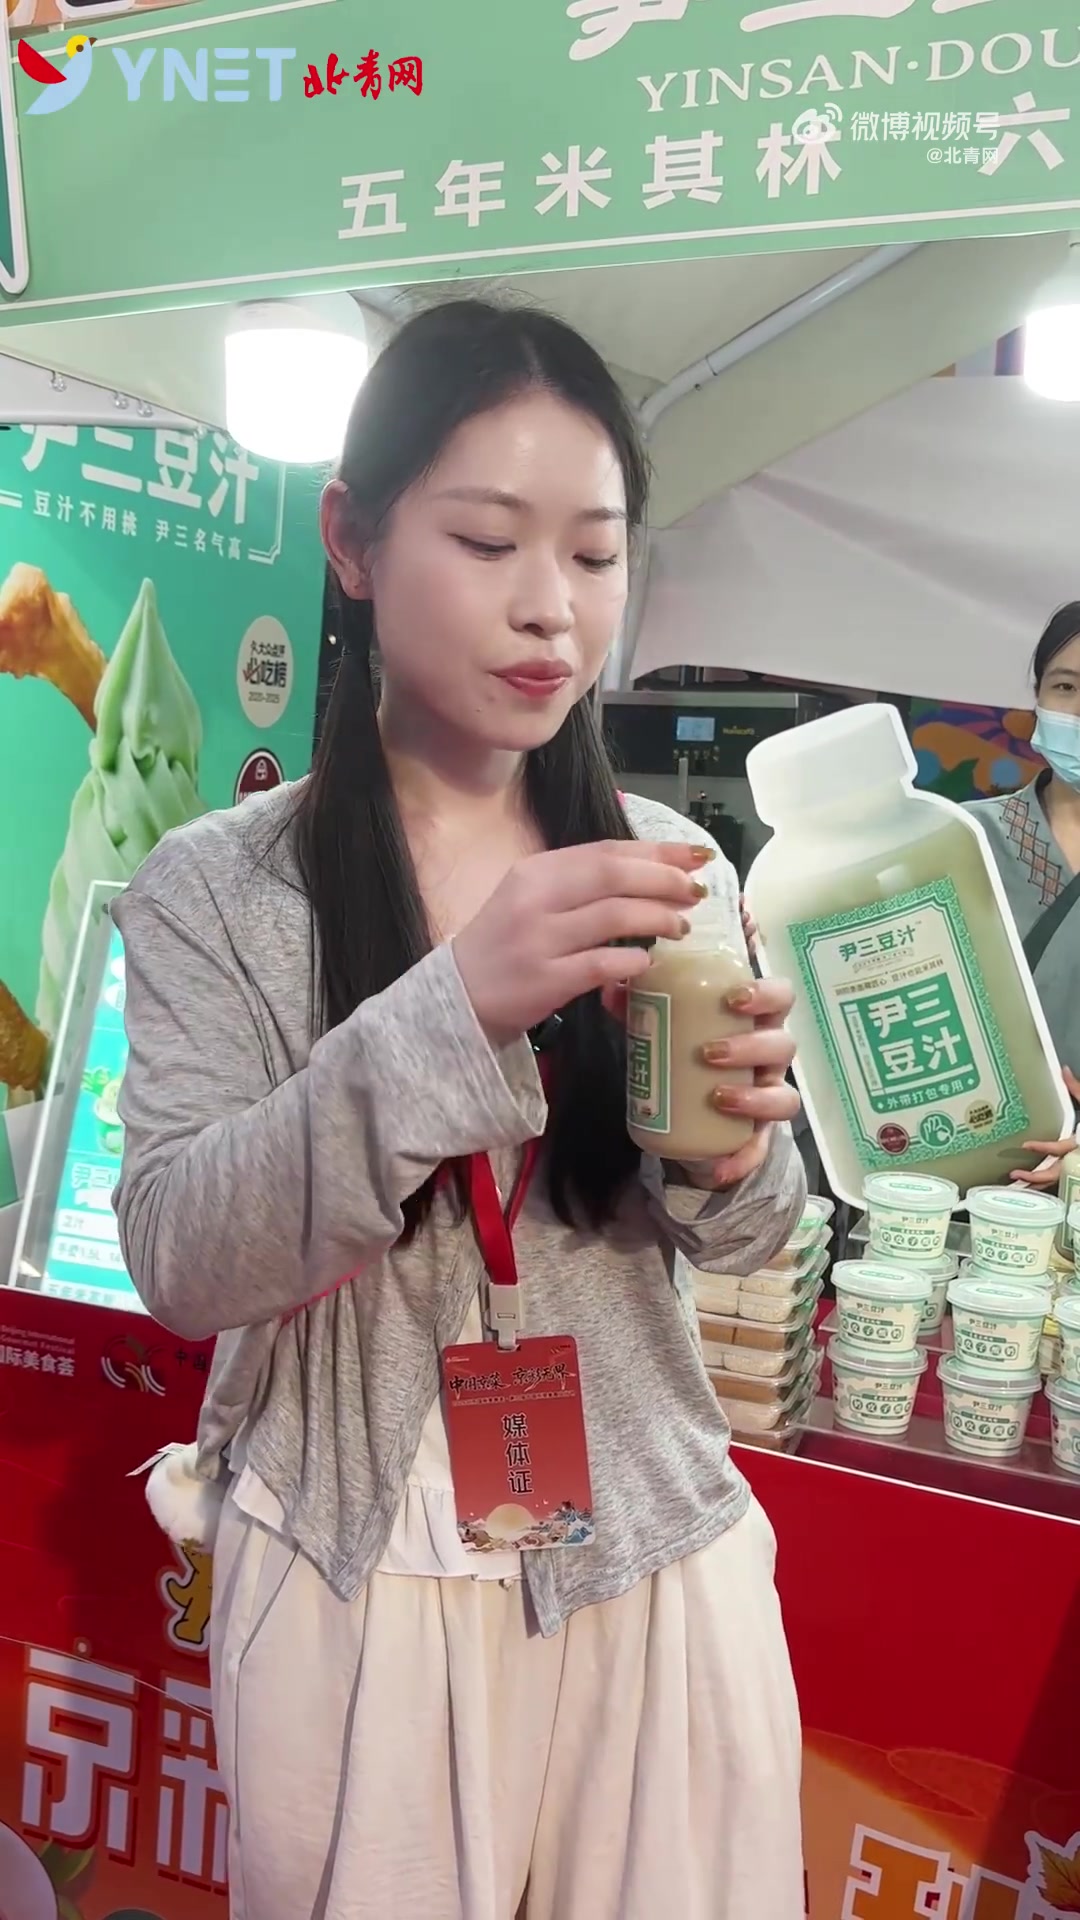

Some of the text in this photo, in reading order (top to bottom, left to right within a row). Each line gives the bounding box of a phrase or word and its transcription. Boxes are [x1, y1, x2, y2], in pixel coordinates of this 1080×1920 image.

[33, 490, 242, 561] 豆汁不用挑 尹三名气高
[838, 924, 917, 962] 尹三豆汁
[867, 983, 952, 1039] 尹三
[877, 1026, 962, 1081] 豆汁
[886, 1078, 964, 1110] 外带打包专用
[502, 1412, 533, 1495] 媒体证
